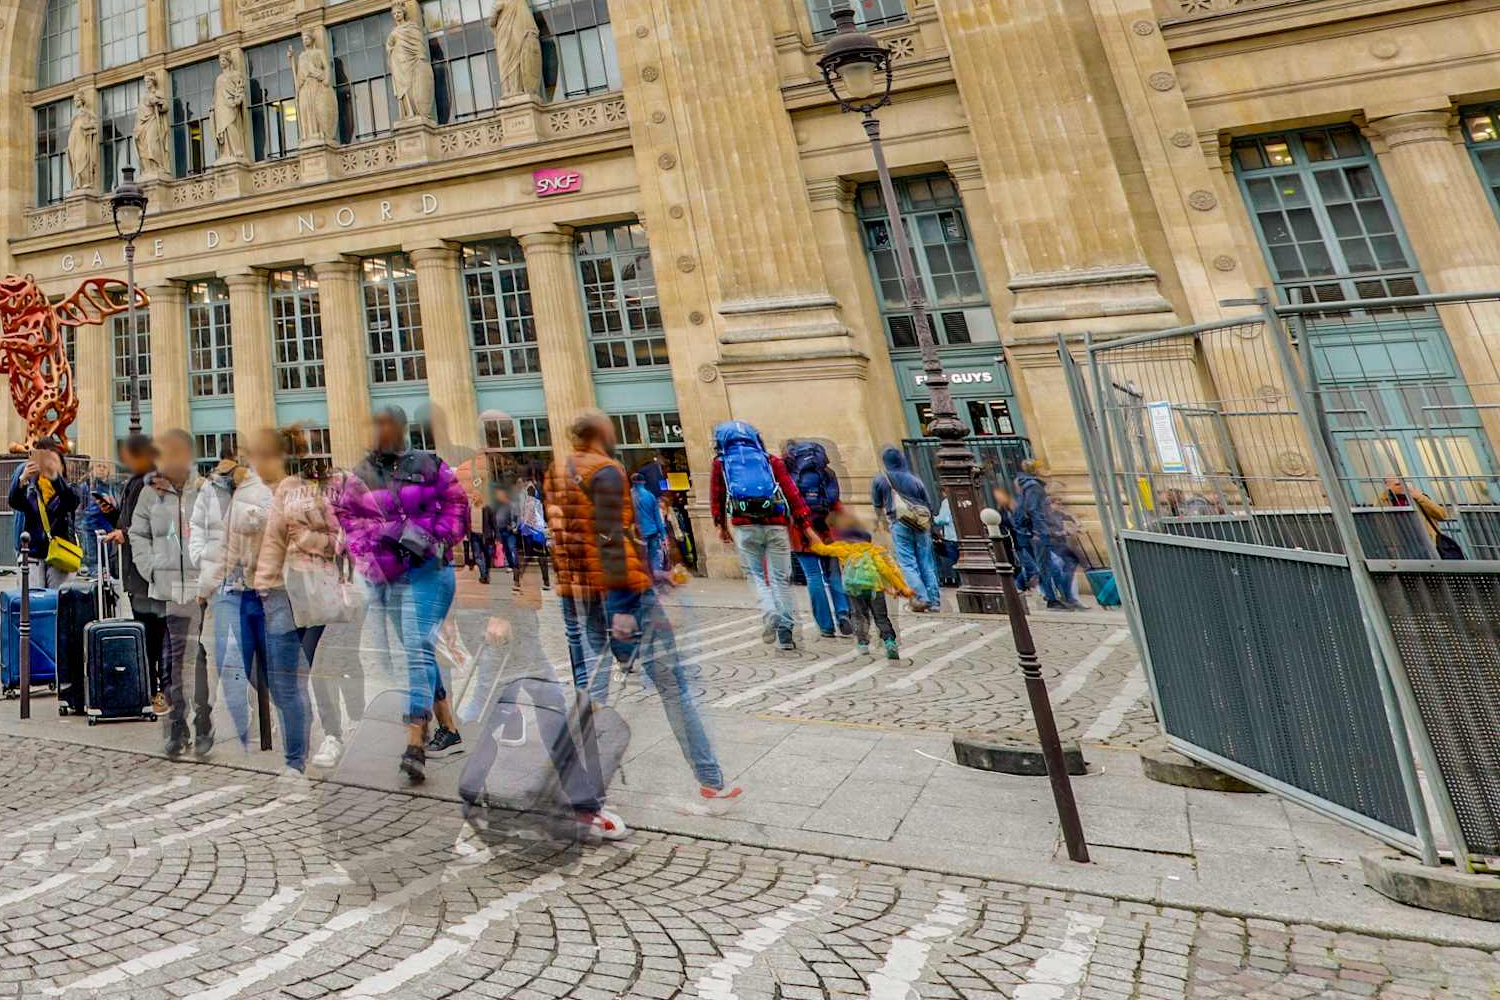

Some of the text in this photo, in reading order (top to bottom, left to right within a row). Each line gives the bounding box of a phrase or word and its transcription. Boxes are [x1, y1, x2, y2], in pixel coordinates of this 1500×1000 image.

[537, 174, 580, 193] SNCF
[207, 223, 255, 249] DU
[298, 193, 438, 233] NORD
[951, 371, 993, 384] GUYS
